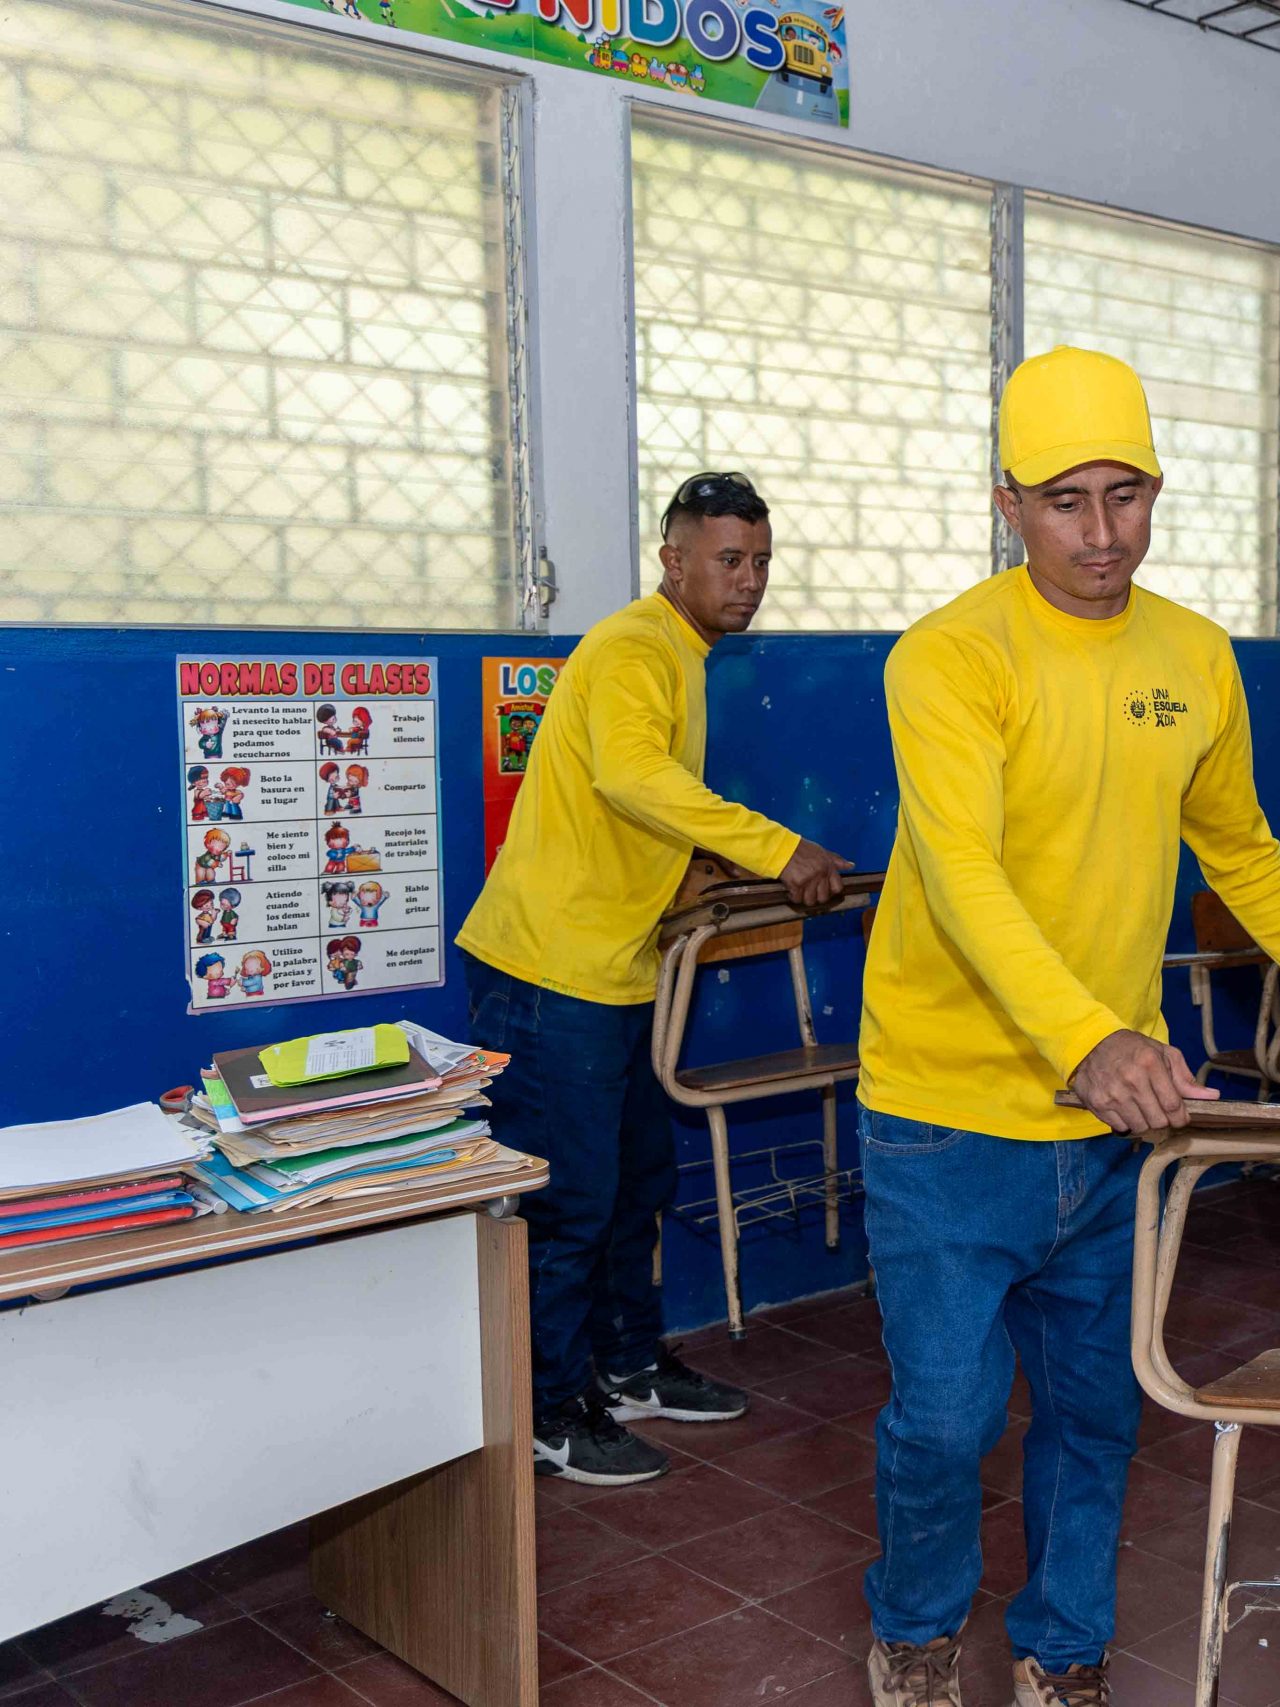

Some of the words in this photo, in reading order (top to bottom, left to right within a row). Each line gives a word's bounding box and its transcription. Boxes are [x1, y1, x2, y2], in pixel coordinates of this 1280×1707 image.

[180, 663, 297, 696] NORMAS
[304, 664, 335, 695] DE
[342, 664, 431, 695] CLASES
[502, 665, 554, 696] LOS
[1152, 688, 1169, 699] UNA
[1154, 701, 1188, 712] ESCUELA
[241, 717, 280, 725] nesecito
[393, 715, 425, 724] Trabajo
[393, 735, 425, 743] silencio
[233, 740, 274, 749] podamos
[233, 750, 291, 758] escucharnos
[261, 775, 280, 783] Boto
[261, 785, 292, 794] basura
[384, 783, 425, 792] Comparto
[274, 796, 297, 805] lugar
[281, 830, 308, 838] siento
[385, 829, 411, 838] Recojo
[267, 842, 285, 850] bien
[385, 839, 428, 847] materiales
[268, 853, 295, 861] coloco
[397, 849, 427, 859] trabajo
[268, 864, 286, 872] silla
[405, 885, 429, 893] Hablo
[266, 891, 302, 899] Atiendo
[267, 901, 299, 910] cuando
[406, 905, 430, 915] gritar
[267, 924, 297, 932] hablan
[273, 948, 303, 956] Utilizo
[400, 947, 435, 957] desplazo
[284, 958, 317, 968] palabra
[399, 959, 422, 967] orden
[273, 969, 304, 978] gracias
[274, 981, 288, 990] por
[291, 979, 315, 988] favor
